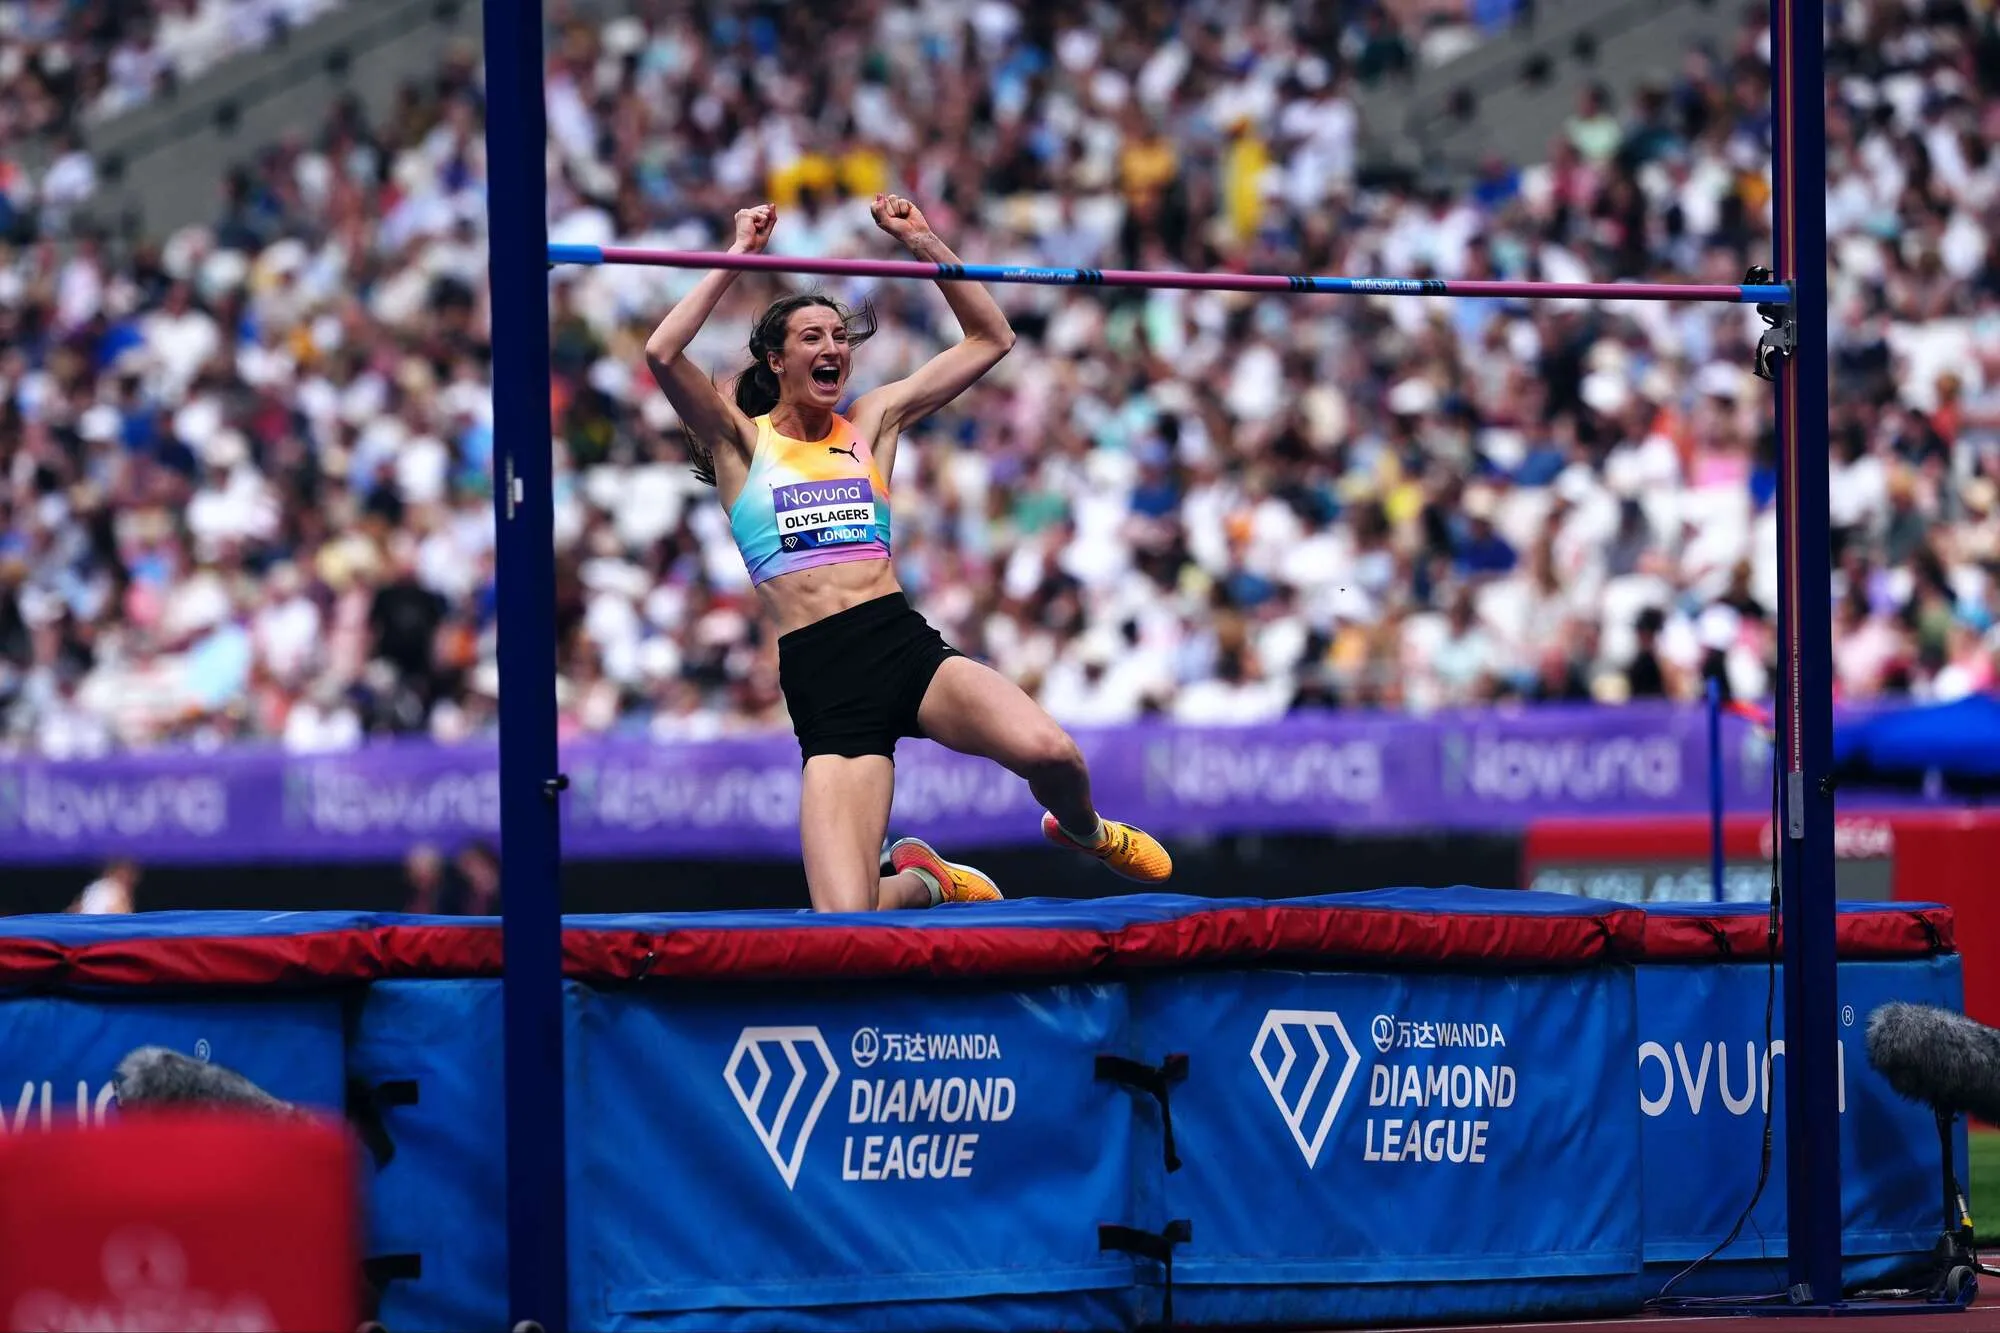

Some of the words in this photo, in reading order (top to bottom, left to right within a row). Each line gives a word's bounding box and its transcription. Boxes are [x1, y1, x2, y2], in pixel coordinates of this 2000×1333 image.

[1350, 278, 1422, 291] nordicsport.com
[782, 486, 861, 507] Novuna
[785, 508, 869, 529] OLYSLAGERS
[817, 527, 867, 543] LONDON
[927, 1034, 1001, 1060] WANDA
[1436, 1023, 1506, 1048] WANDA
[1369, 1064, 1516, 1108] DIAMOND
[848, 1077, 1017, 1124] DIAMOND
[1363, 1118, 1489, 1164] LEAGUE
[842, 1133, 979, 1182] LEAGUE
